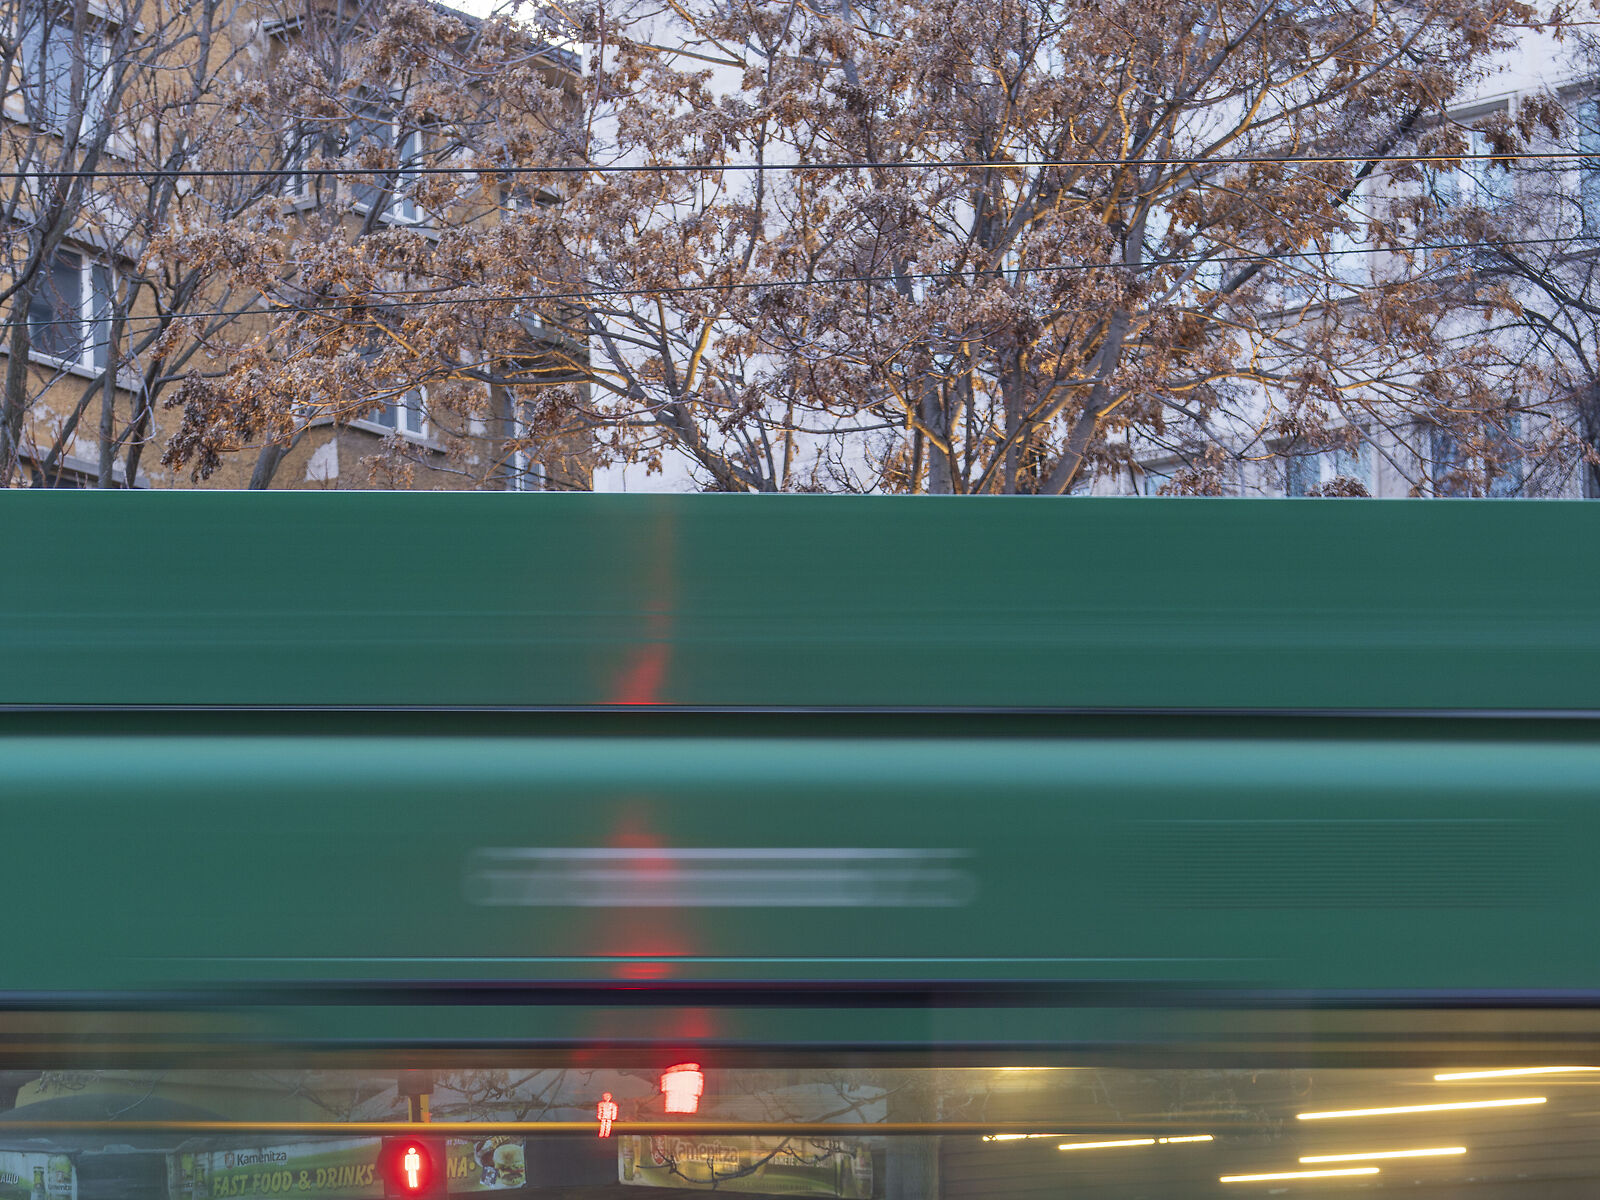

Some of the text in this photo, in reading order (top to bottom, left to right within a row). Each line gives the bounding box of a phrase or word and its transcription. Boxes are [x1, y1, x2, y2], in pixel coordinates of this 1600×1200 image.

[237, 1150, 287, 1166] Kamenitza
[670, 1138, 738, 1163] Kamenitza
[213, 1174, 249, 1197] FAST
[252, 1170, 293, 1193] FOOD
[300, 1170, 311, 1191] &
[316, 1163, 375, 1188] DRINKS
